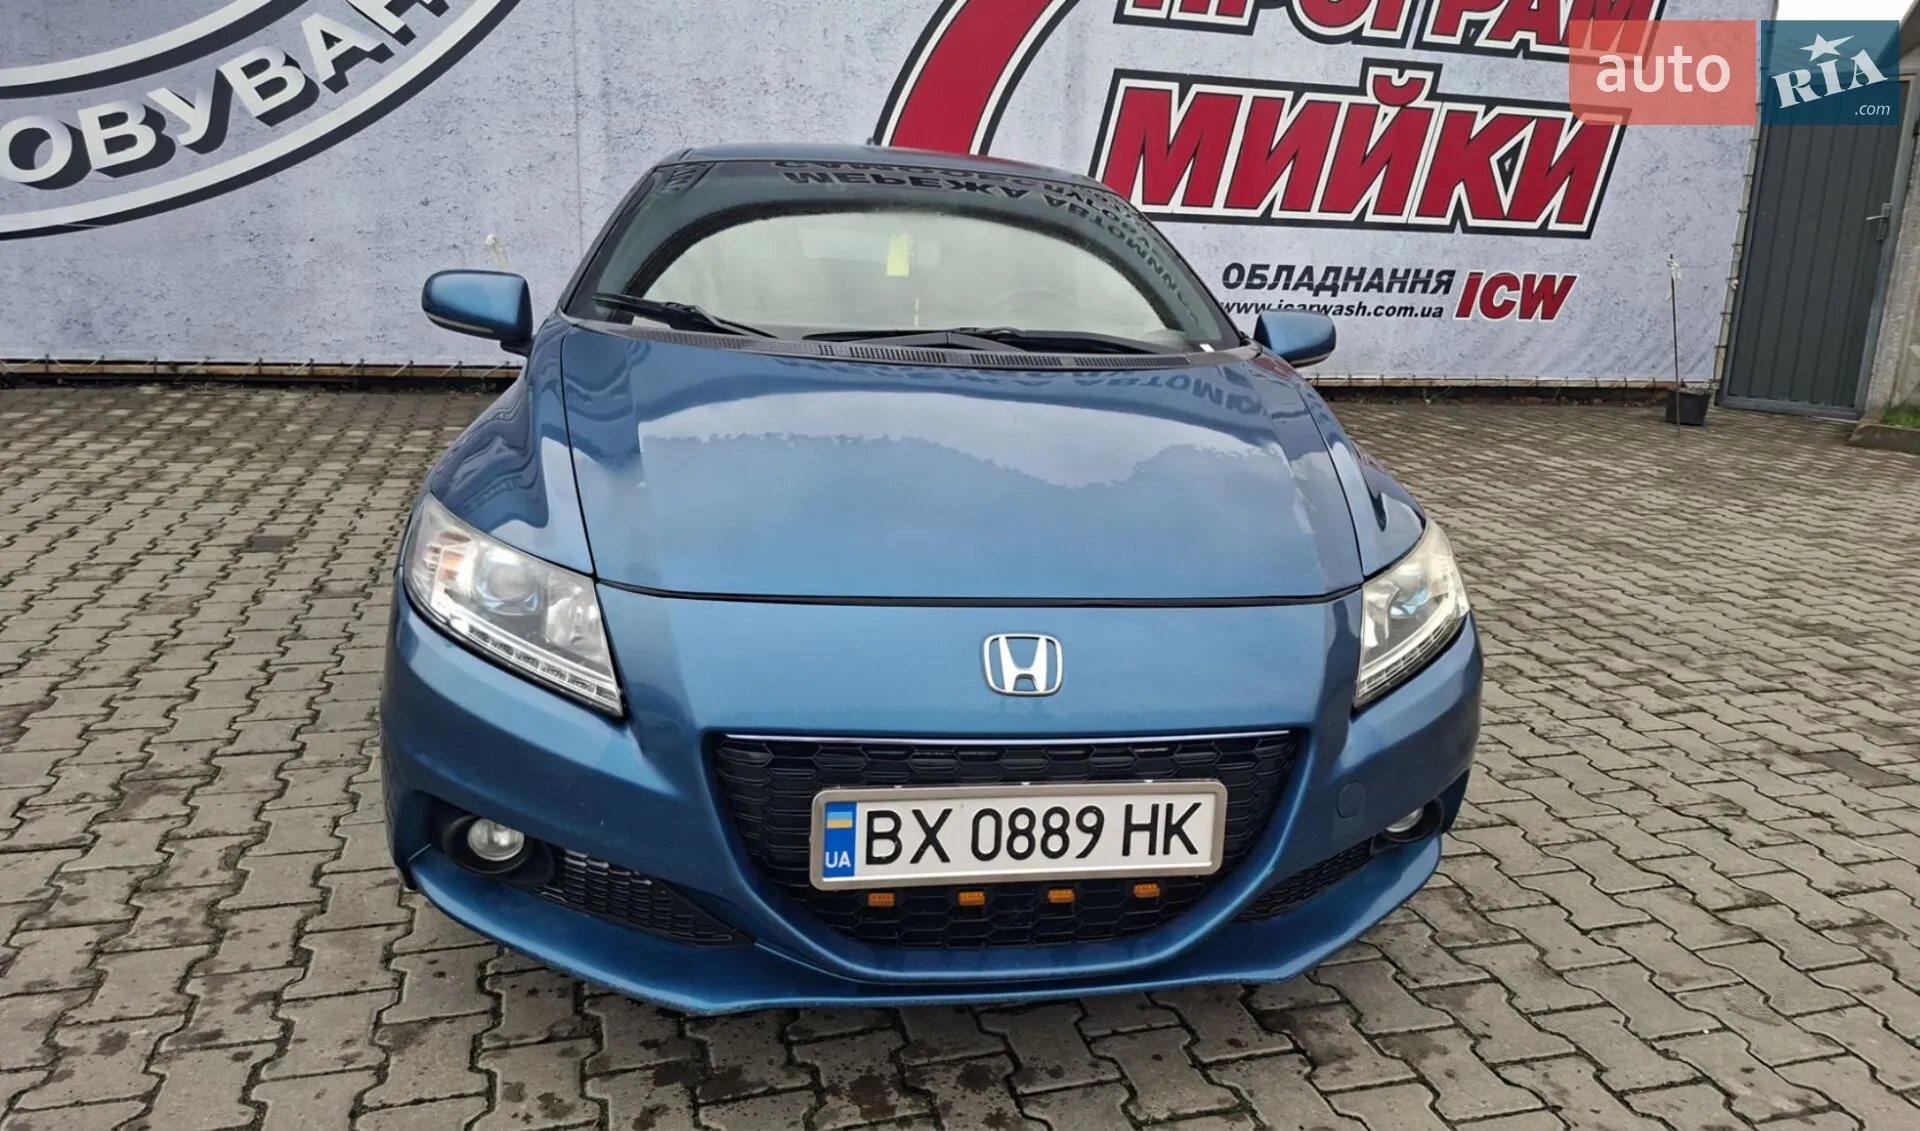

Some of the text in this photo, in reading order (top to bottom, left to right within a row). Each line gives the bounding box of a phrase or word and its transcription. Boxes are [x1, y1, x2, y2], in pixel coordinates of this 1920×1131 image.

[1093, 66, 1624, 232] МИЙКИ
[1221, 262, 1456, 298] ОБЛАДНАННЯ
[1453, 269, 1579, 321] ICW
[1220, 299, 1443, 319] wwwicarwash.com.ua
[866, 802, 1202, 865] BX 0889 HK
[825, 850, 851, 869] UA
